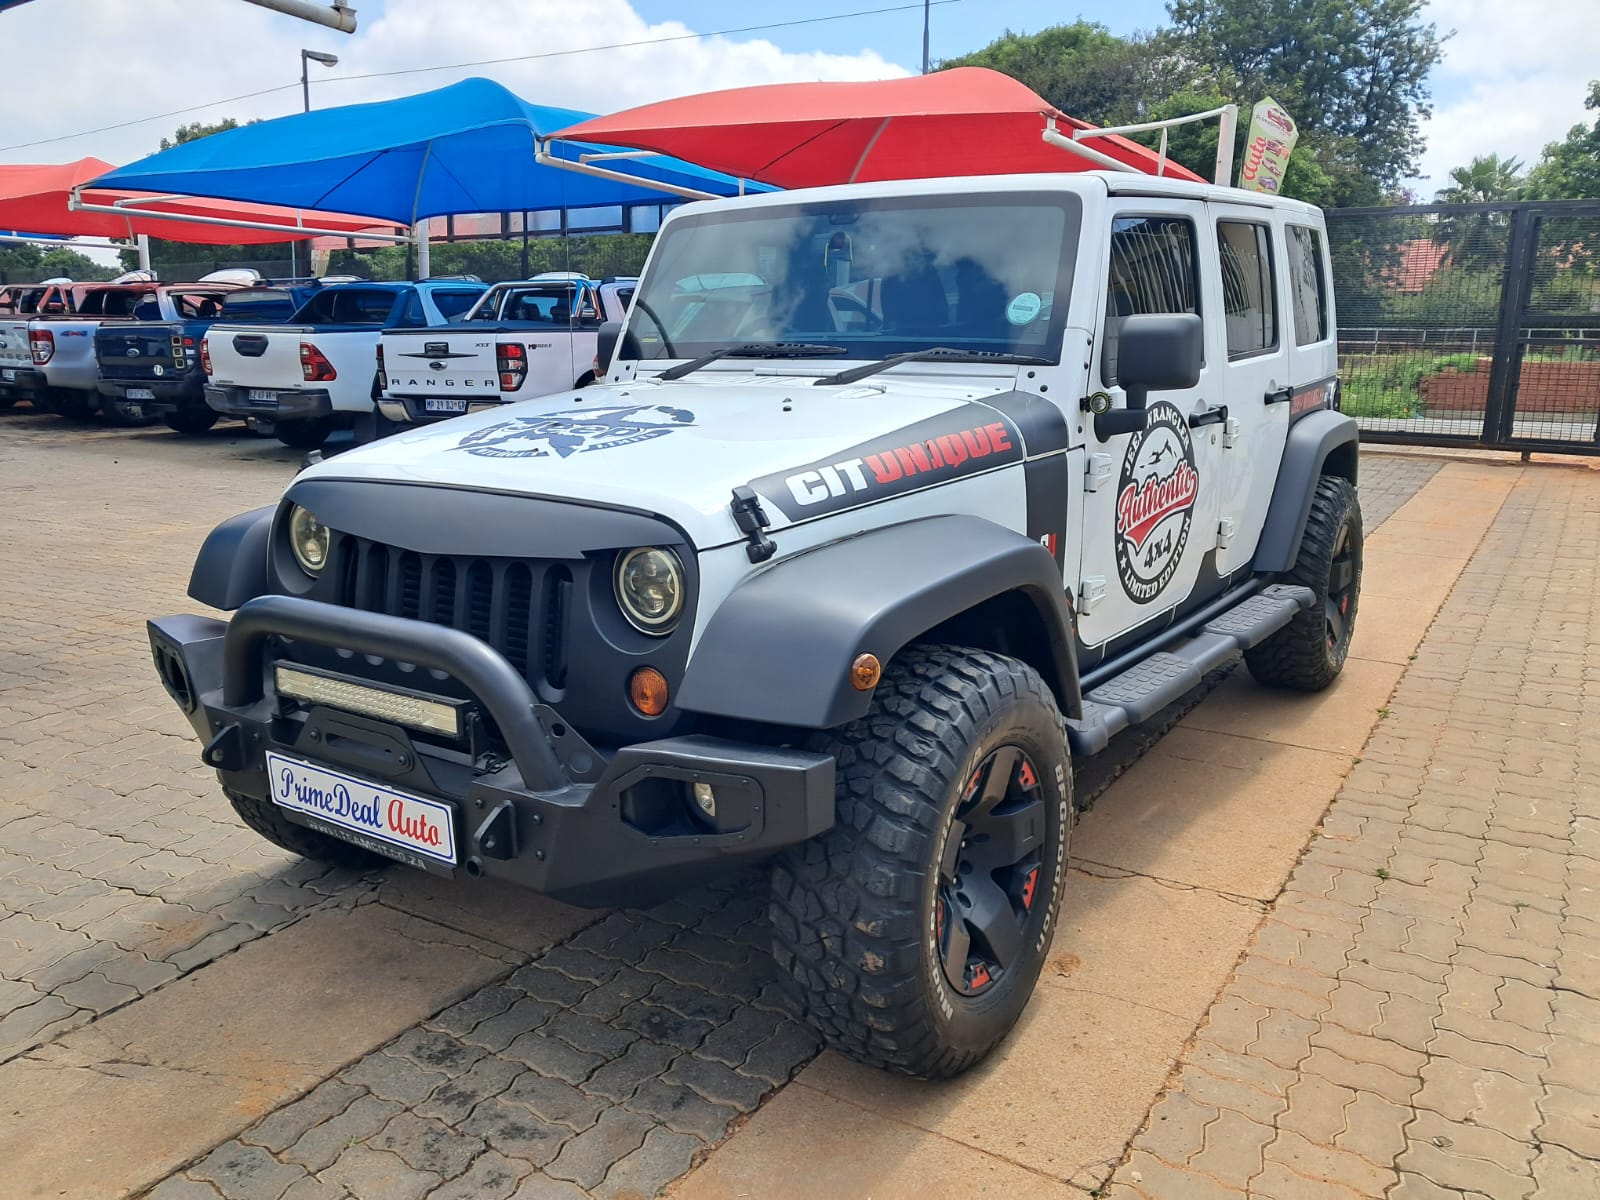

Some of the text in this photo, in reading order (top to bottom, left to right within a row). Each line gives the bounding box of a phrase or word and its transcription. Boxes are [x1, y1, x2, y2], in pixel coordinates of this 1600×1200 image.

[1243, 137, 1266, 181] Auto
[391, 379, 495, 387] RANGER
[1119, 460, 1198, 533] Authentic
[1125, 516, 1190, 598] LIMITED EDITION
[281, 767, 442, 846] PrimeDeal Auto
